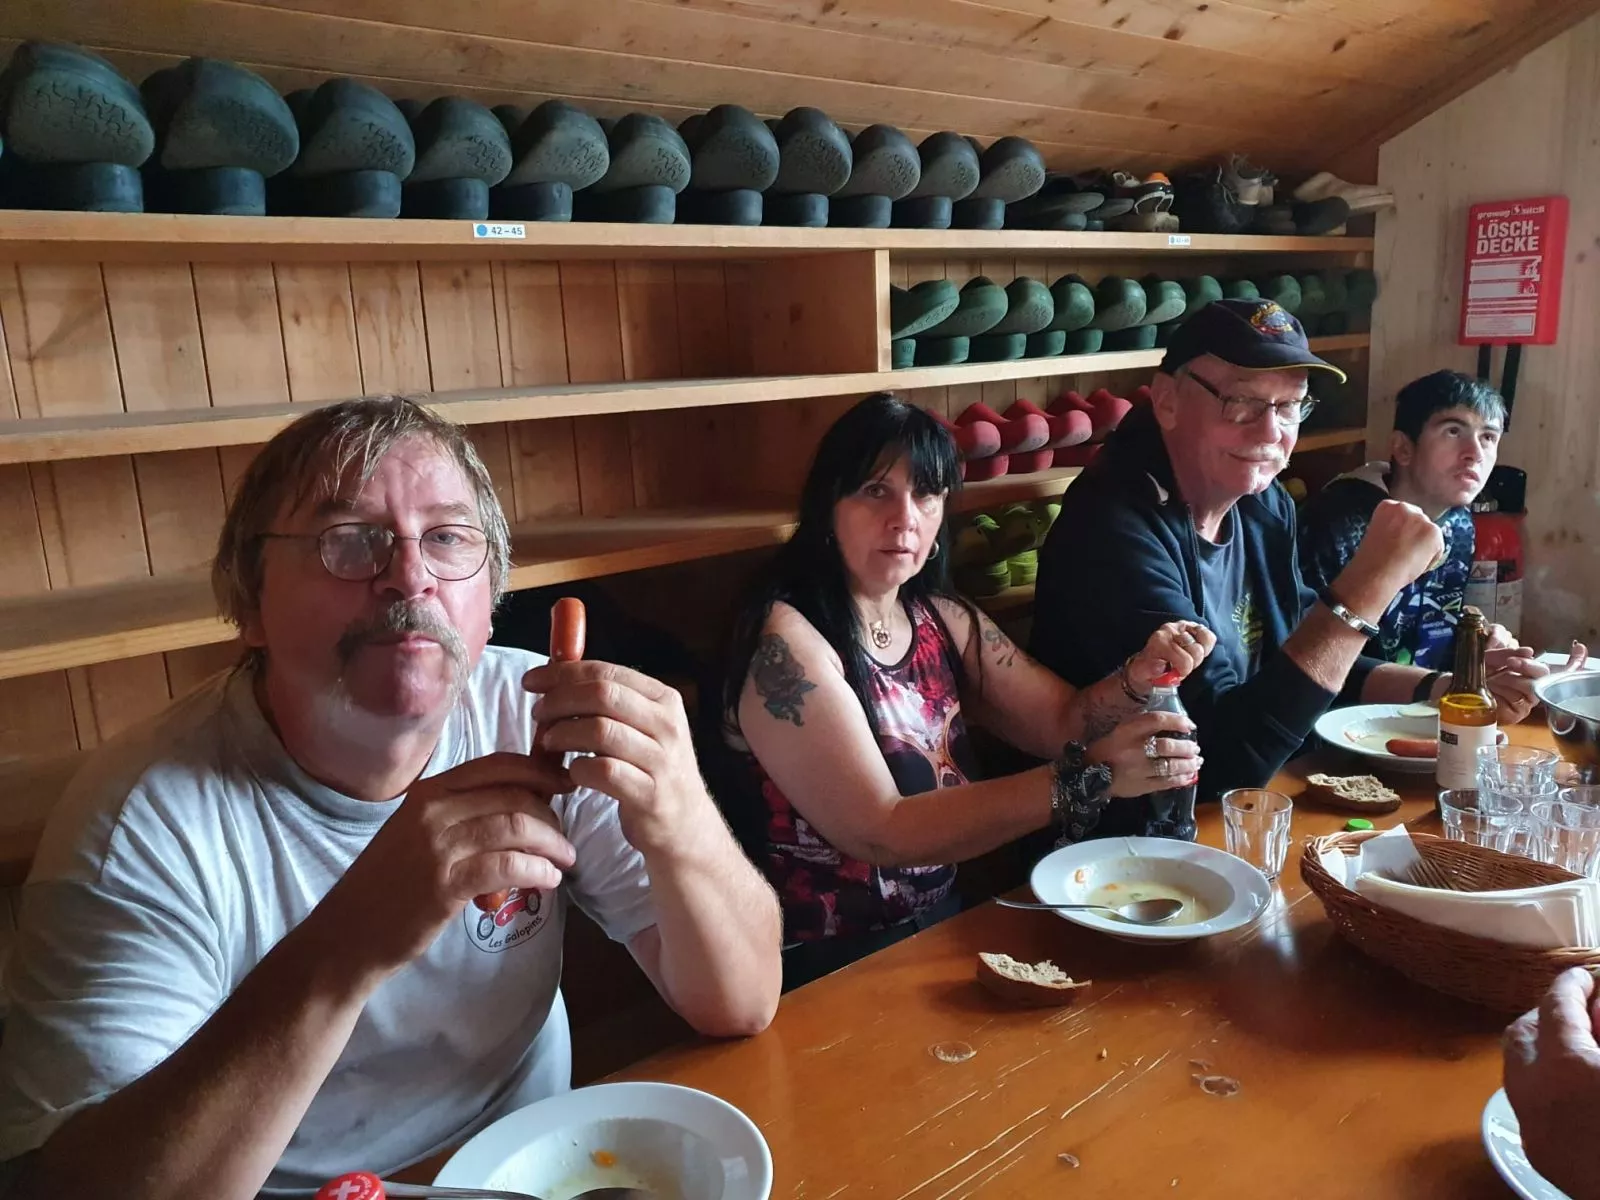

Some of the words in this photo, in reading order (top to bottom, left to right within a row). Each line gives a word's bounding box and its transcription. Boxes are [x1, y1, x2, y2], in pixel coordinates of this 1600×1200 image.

[1478, 219, 1540, 239] LÖSCH-
[1476, 236, 1540, 255] DECKE
[488, 937, 503, 948] Les
[505, 914, 543, 944] Galopins
